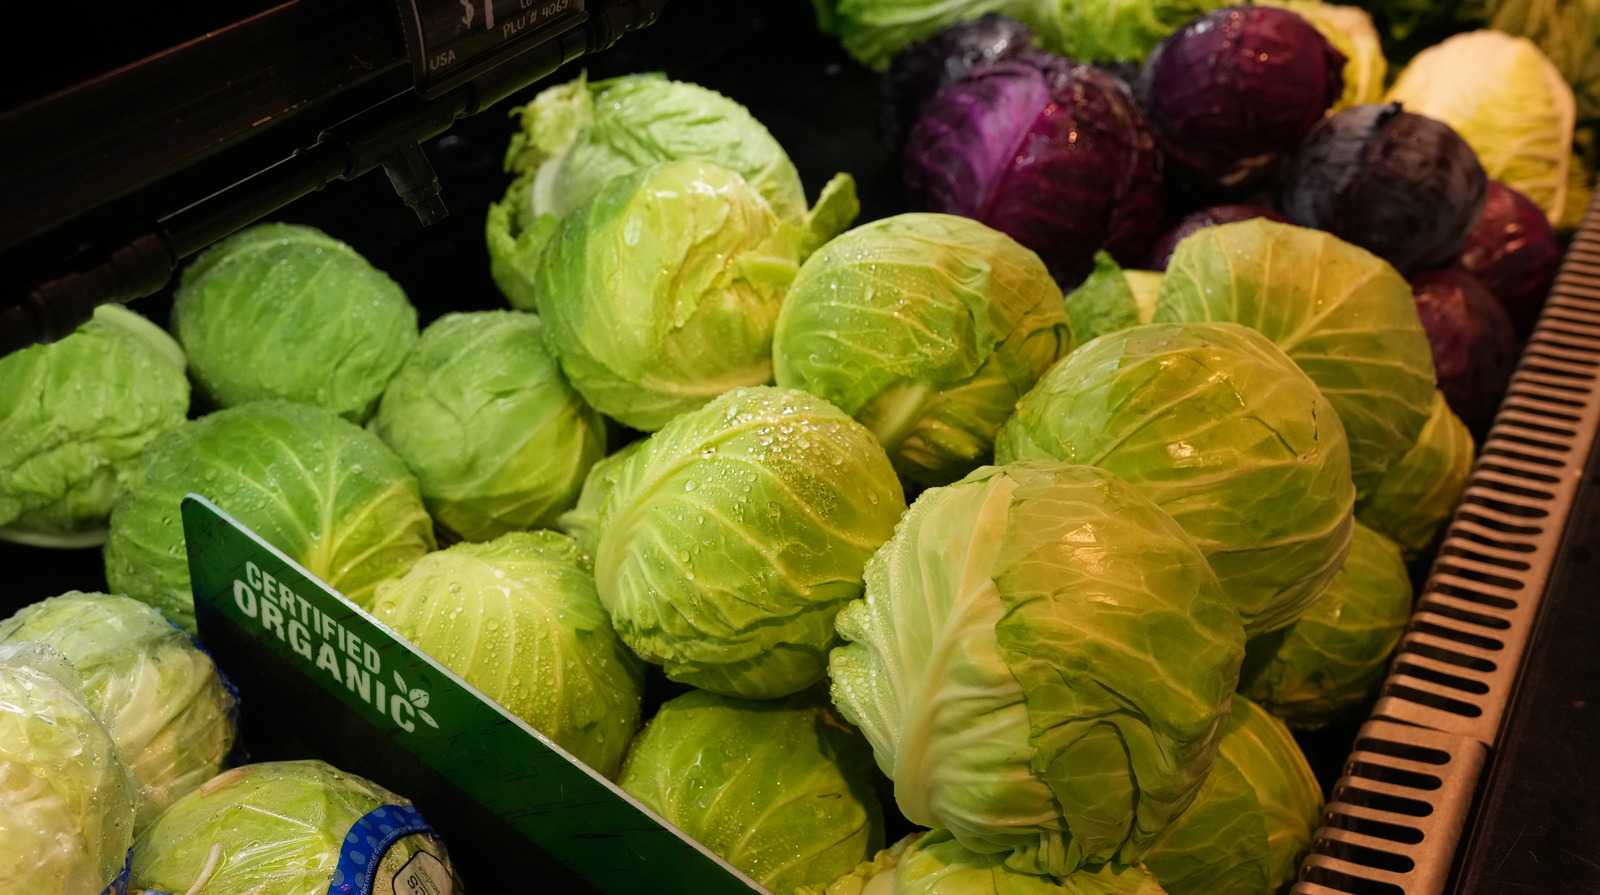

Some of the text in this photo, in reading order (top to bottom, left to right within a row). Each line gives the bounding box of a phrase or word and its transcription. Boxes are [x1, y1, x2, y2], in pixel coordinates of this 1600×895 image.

[502, 0, 569, 39] PLU # 4069
[429, 49, 457, 71] USA
[246, 561, 381, 675] CERTIFIED
[233, 579, 415, 733] ORGANIC
[417, 865, 441, 895] produce
